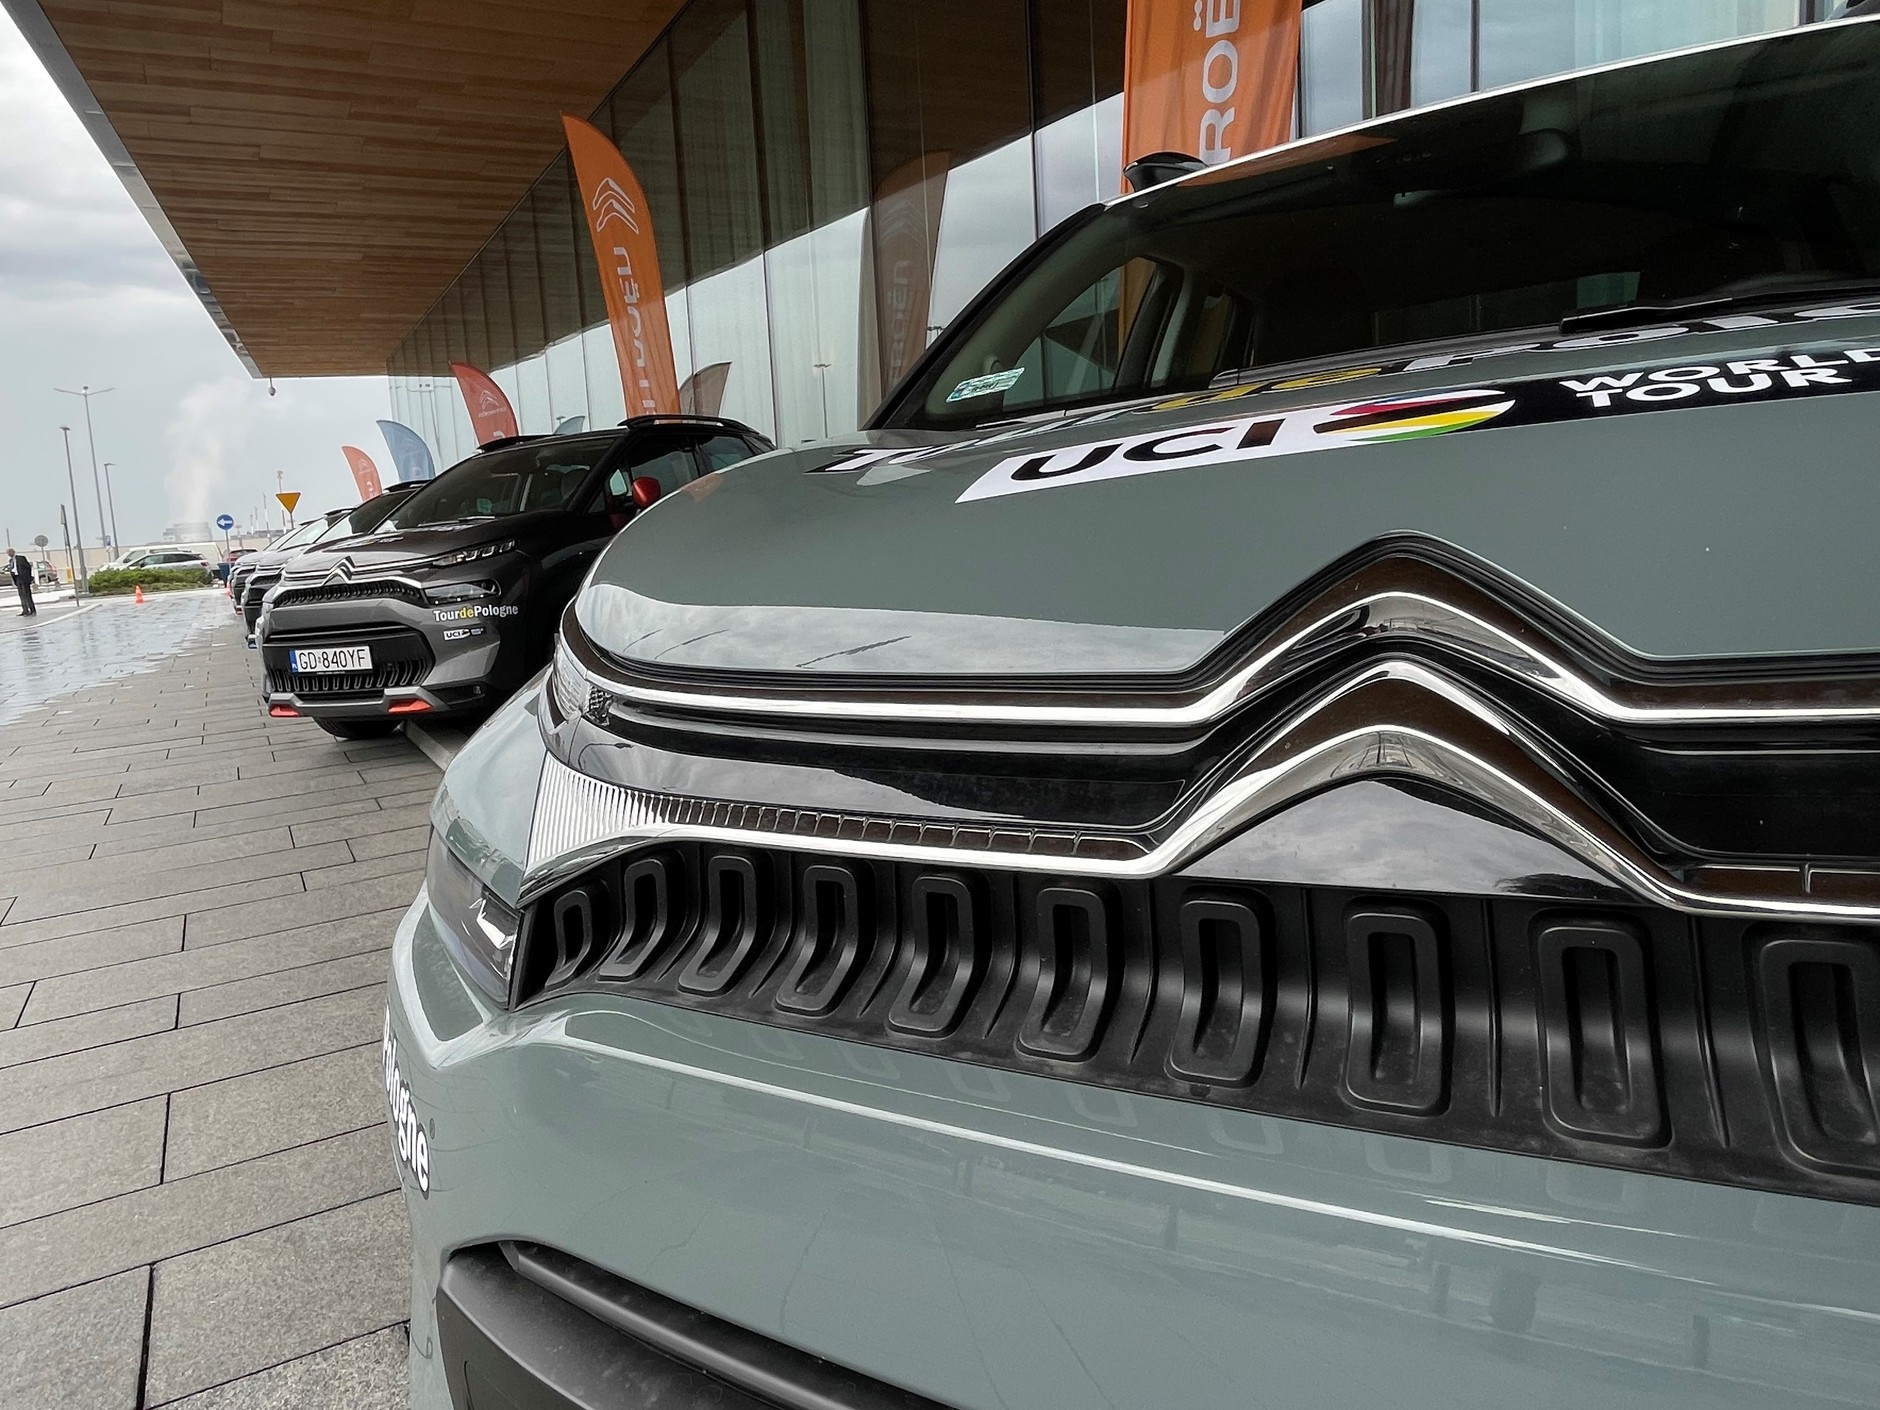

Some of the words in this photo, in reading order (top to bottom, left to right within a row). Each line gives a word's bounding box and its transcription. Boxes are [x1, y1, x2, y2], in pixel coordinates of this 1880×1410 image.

[1575, 368, 1853, 408] TOUR
[1011, 418, 1286, 481] UCI
[299, 652, 317, 670] GD
[321, 648, 366, 669] 840YF
